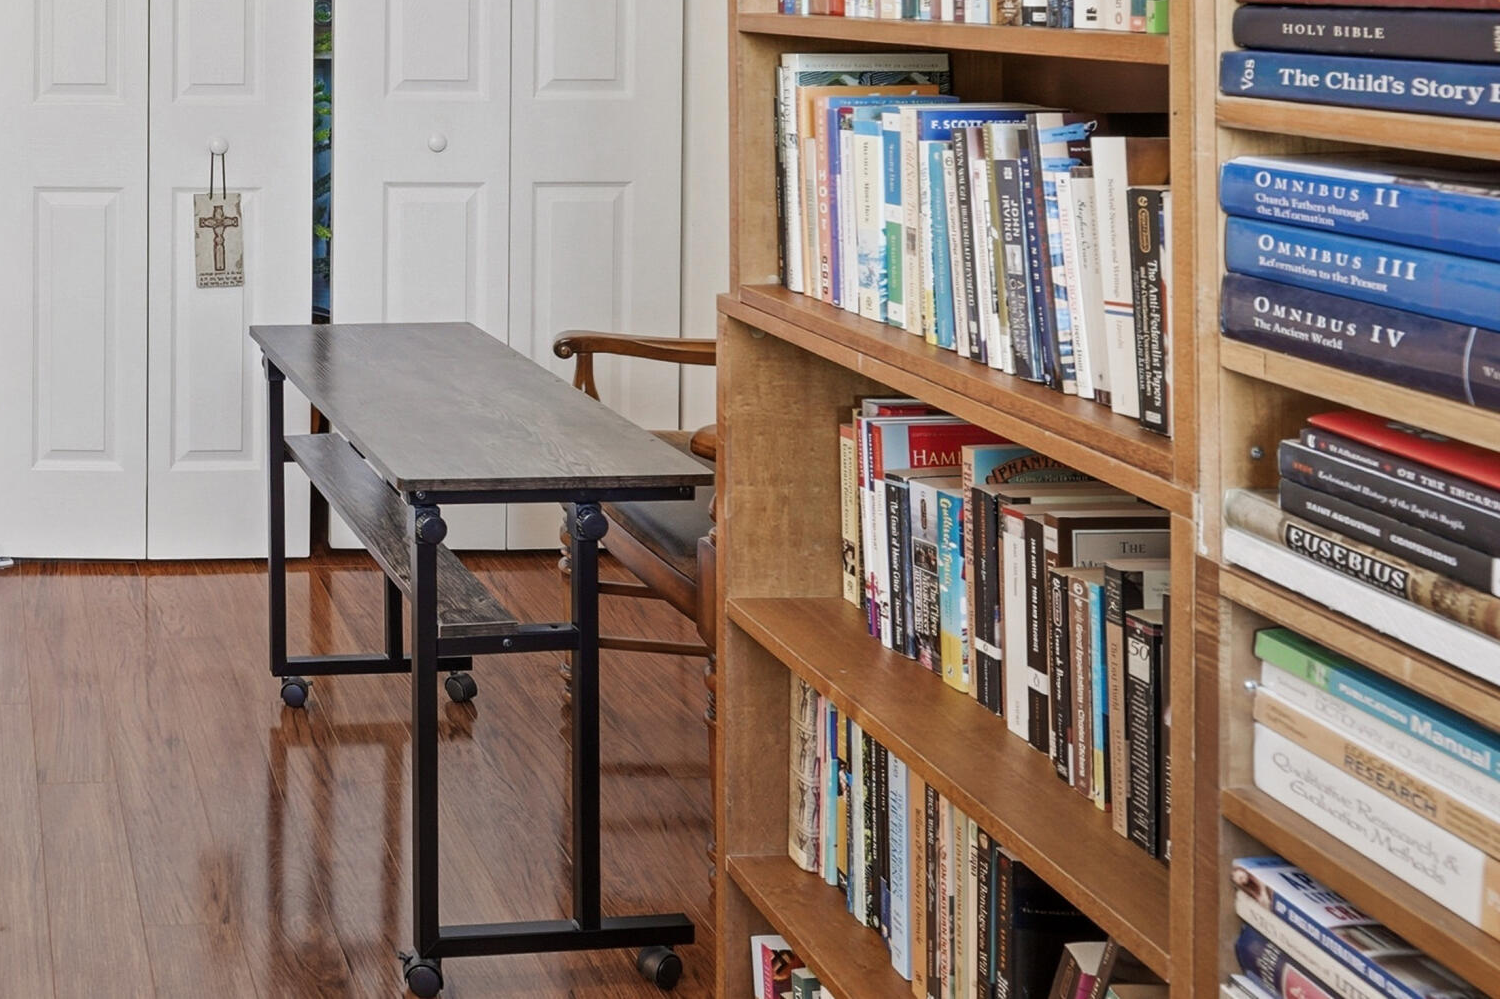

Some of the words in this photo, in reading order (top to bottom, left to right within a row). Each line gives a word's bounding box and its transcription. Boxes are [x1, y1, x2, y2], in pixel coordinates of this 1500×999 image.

[1282, 23, 1326, 36] HOLY
[1333, 25, 1386, 40] BIBLE
[1240, 59, 1256, 91] Vos
[1278, 67, 1320, 87] The
[1324, 70, 1405, 95] Child's
[1411, 77, 1485, 106] Story
[930, 119, 941, 130] F.
[943, 119, 983, 129] SCOTT
[1254, 171, 1360, 202] OMNIBUS
[1374, 187, 1400, 208] II
[1002, 195, 1013, 242] IRVING
[1010, 200, 1021, 238] JOHN
[1254, 193, 1290, 208] Church
[1290, 196, 1326, 213] Fathers
[1327, 203, 1369, 222] through
[1256, 205, 1272, 215] the
[1273, 206, 1335, 227] Reformation
[1147, 260, 1158, 282] The
[1257, 234, 1363, 269] OMNIBUS
[1376, 256, 1418, 281] III
[1258, 256, 1318, 278] Reformation
[1318, 268, 1330, 280] to
[1331, 270, 1349, 284] the
[1349, 274, 1389, 293] Present
[1148, 285, 1161, 366] Anti-Federalist
[1253, 296, 1357, 337] OMNIBUS
[1370, 324, 1406, 349] IV
[1253, 316, 1271, 329] The
[1272, 323, 1310, 343] Ancient
[1311, 333, 1344, 350] World
[1150, 368, 1162, 407] Papers
[1420, 475, 1445, 492] THE
[940, 497, 956, 551] Gulliver's
[1119, 541, 1147, 554] THE
[1289, 527, 1406, 591] EUSEBIUS
[921, 573, 931, 636] Musketeers
[929, 582, 938, 601] The
[930, 602, 939, 636] Three
[1076, 623, 1085, 650] Great
[1130, 639, 1150, 661] 50
[1410, 714, 1491, 772] Manual
[1343, 754, 1438, 819] RESEARCH
[979, 861, 989, 882] The
[978, 883, 989, 931] Bondage
[979, 950, 989, 976] Will
